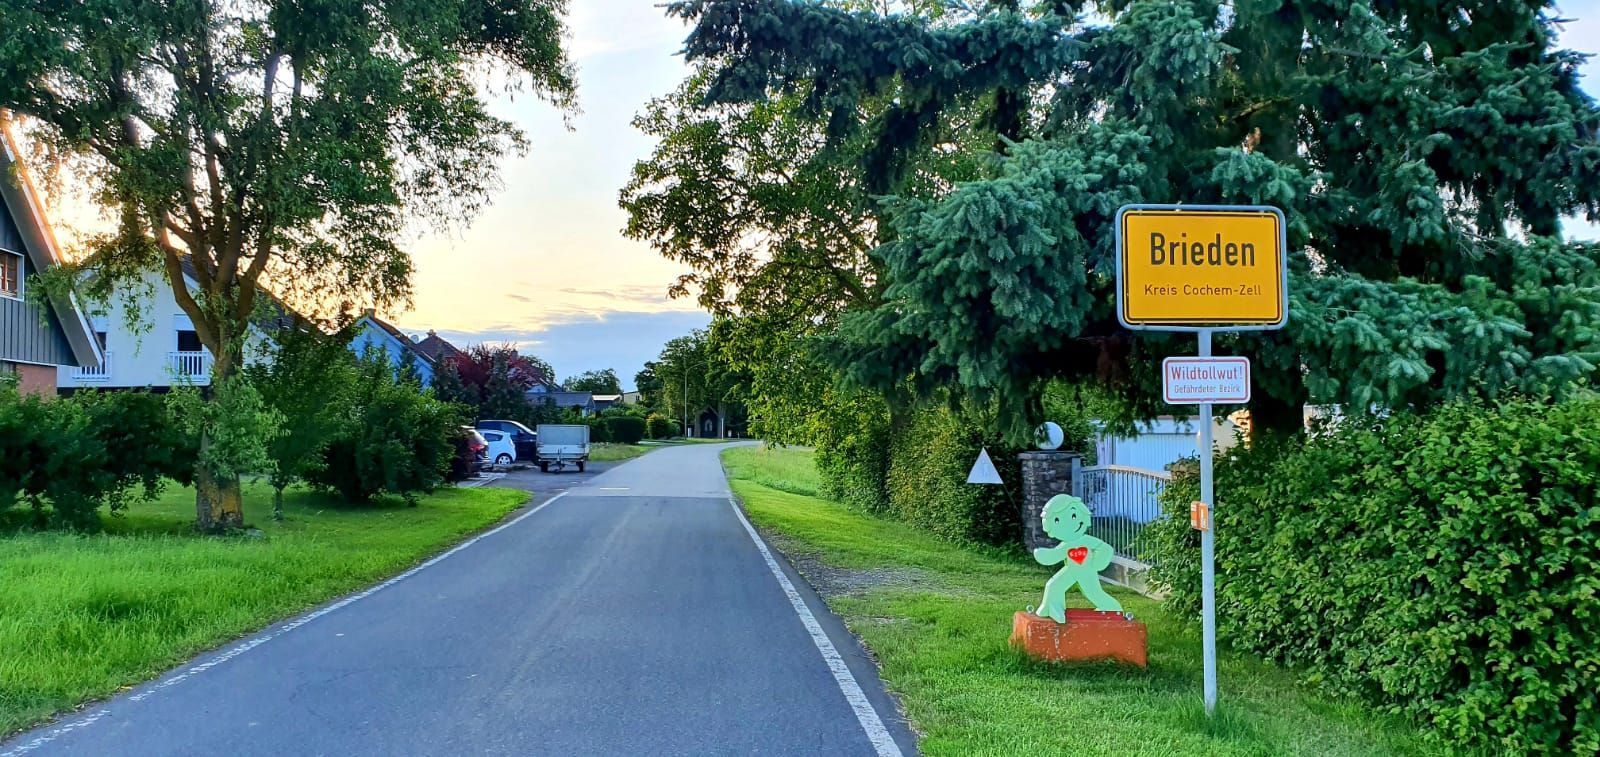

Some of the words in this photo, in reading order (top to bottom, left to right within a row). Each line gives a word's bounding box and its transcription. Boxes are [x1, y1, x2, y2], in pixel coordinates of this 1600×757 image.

[1150, 232, 1255, 266] Brieden
[1144, 284, 1178, 296] Kreis
[1183, 284, 1262, 296] Cochem-Zell
[1171, 366, 1243, 380] Wildtollwut!
[1174, 384, 1216, 394] Gefährdeter
[1219, 384, 1240, 393] Bezirk
